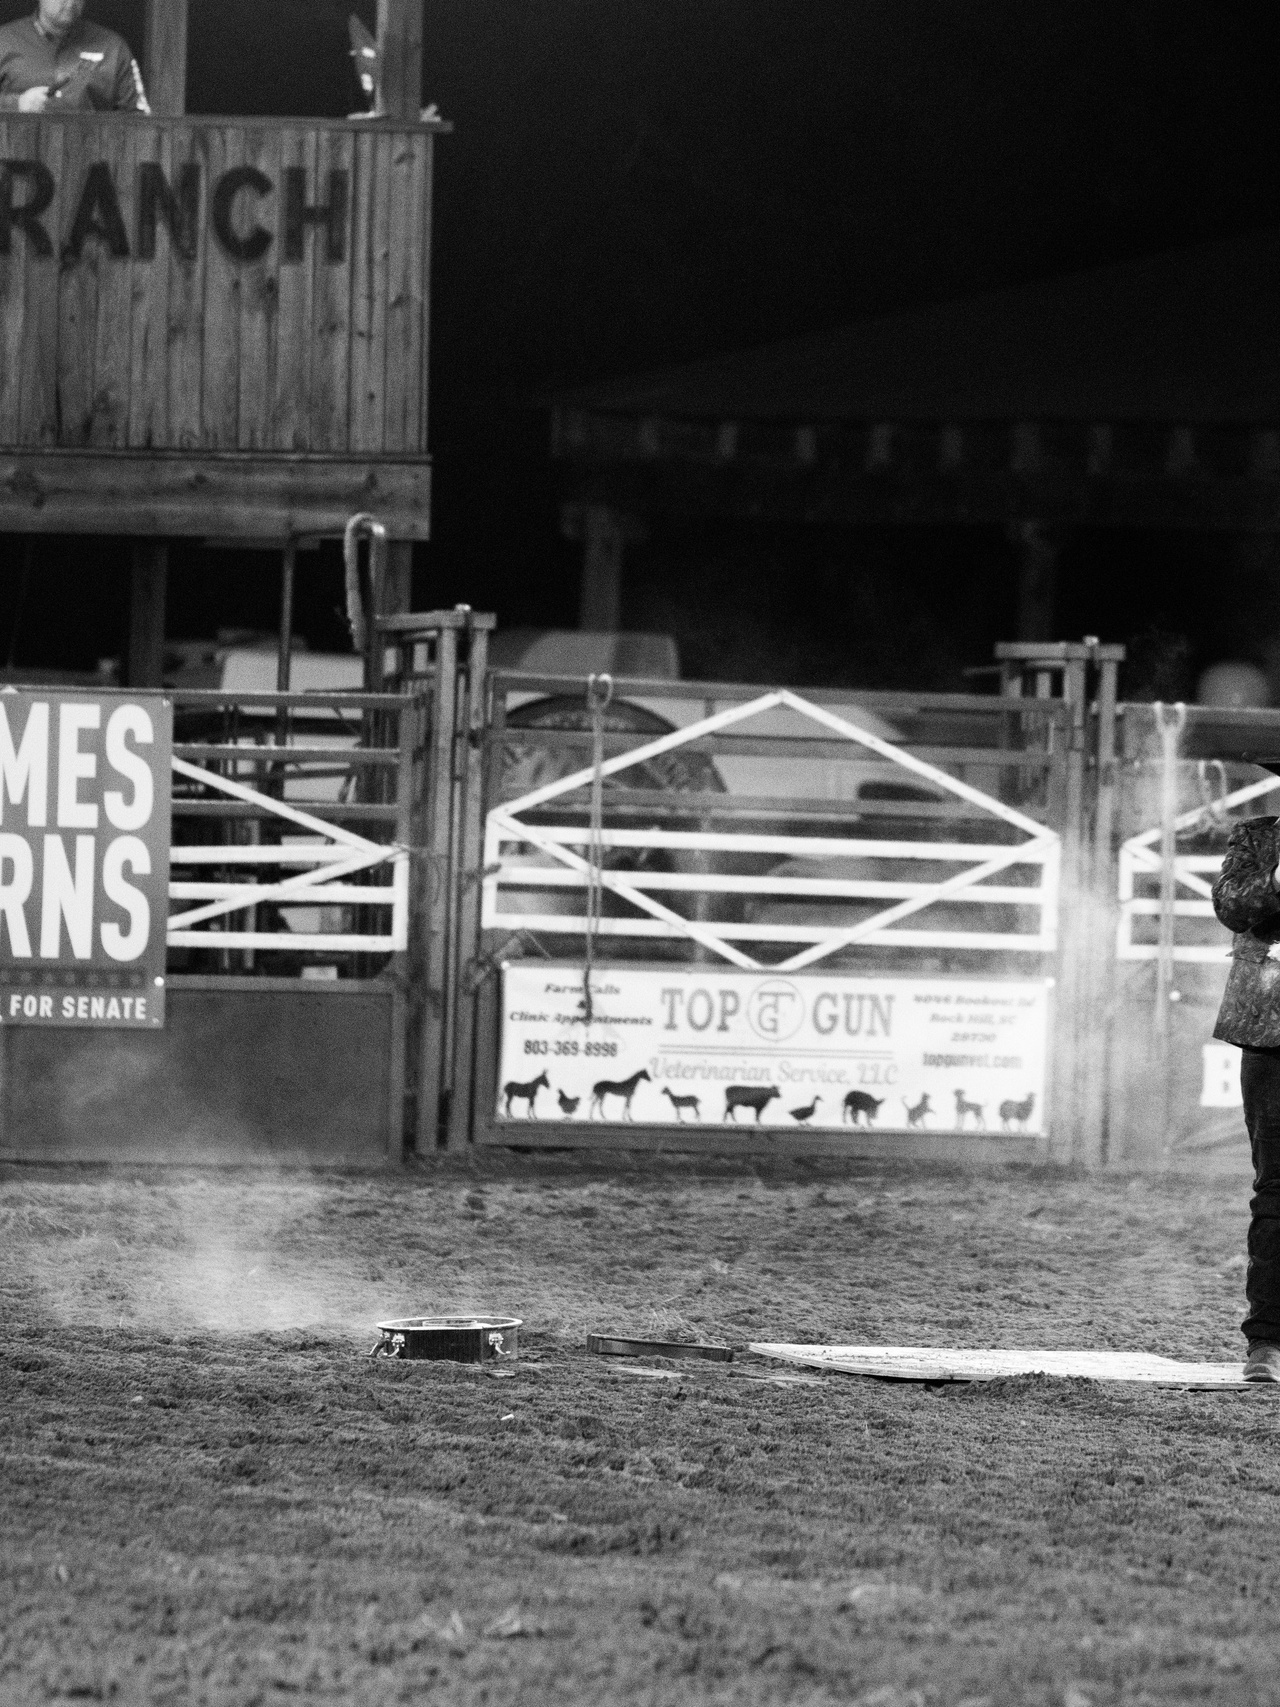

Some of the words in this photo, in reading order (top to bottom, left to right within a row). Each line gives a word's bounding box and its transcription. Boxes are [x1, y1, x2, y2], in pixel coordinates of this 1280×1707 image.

[0, 160, 350, 266] RANCH
[9, 994, 53, 1018] FOR
[61, 995, 147, 1020] SENATE
[509, 1011, 550, 1023] Clinic
[661, 987, 740, 1032] TOP
[812, 992, 896, 1037] GUN
[649, 1057, 772, 1083] Veterinarian
[857, 1063, 899, 1086] LLC
